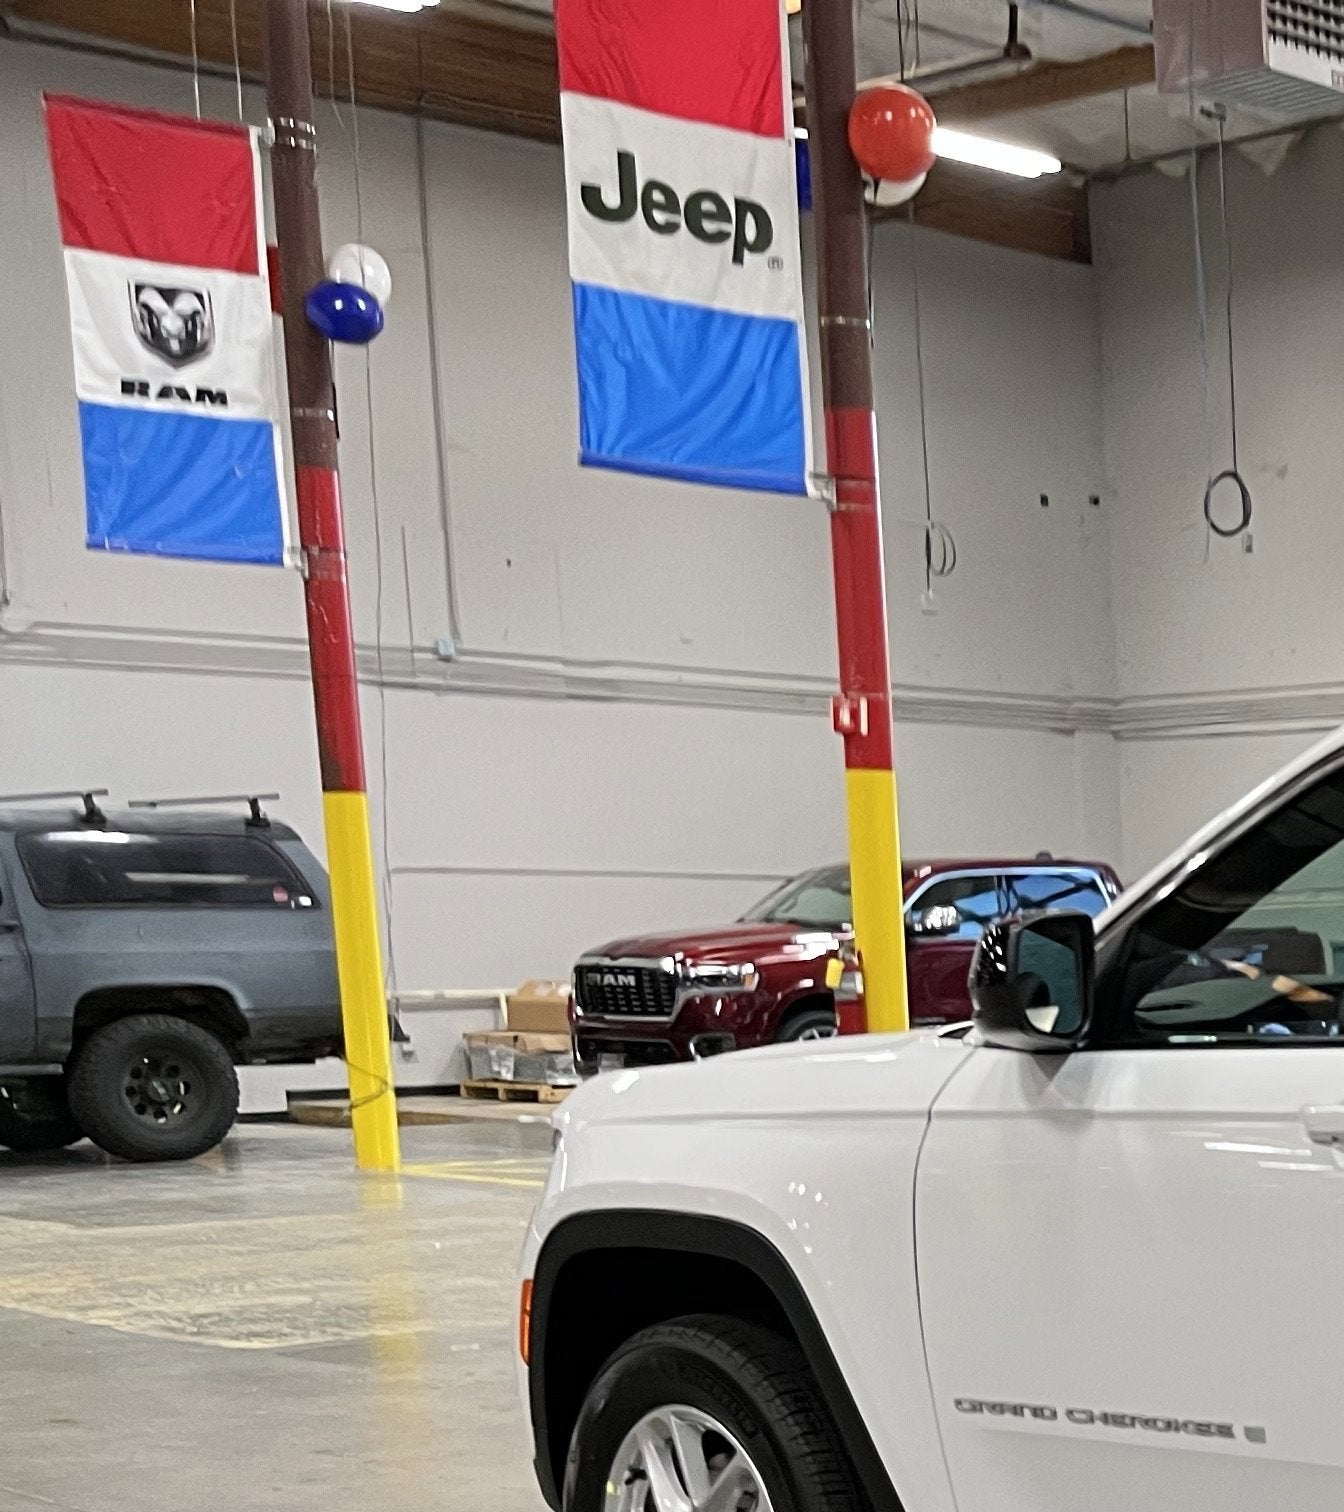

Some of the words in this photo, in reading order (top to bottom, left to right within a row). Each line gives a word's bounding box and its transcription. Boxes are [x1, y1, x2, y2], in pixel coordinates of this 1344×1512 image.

[580, 149, 774, 267] Jeep
[120, 380, 229, 406] RAM
[954, 1398, 1058, 1421] GRAND
[1065, 1408, 1236, 1439] CHEROKEE
